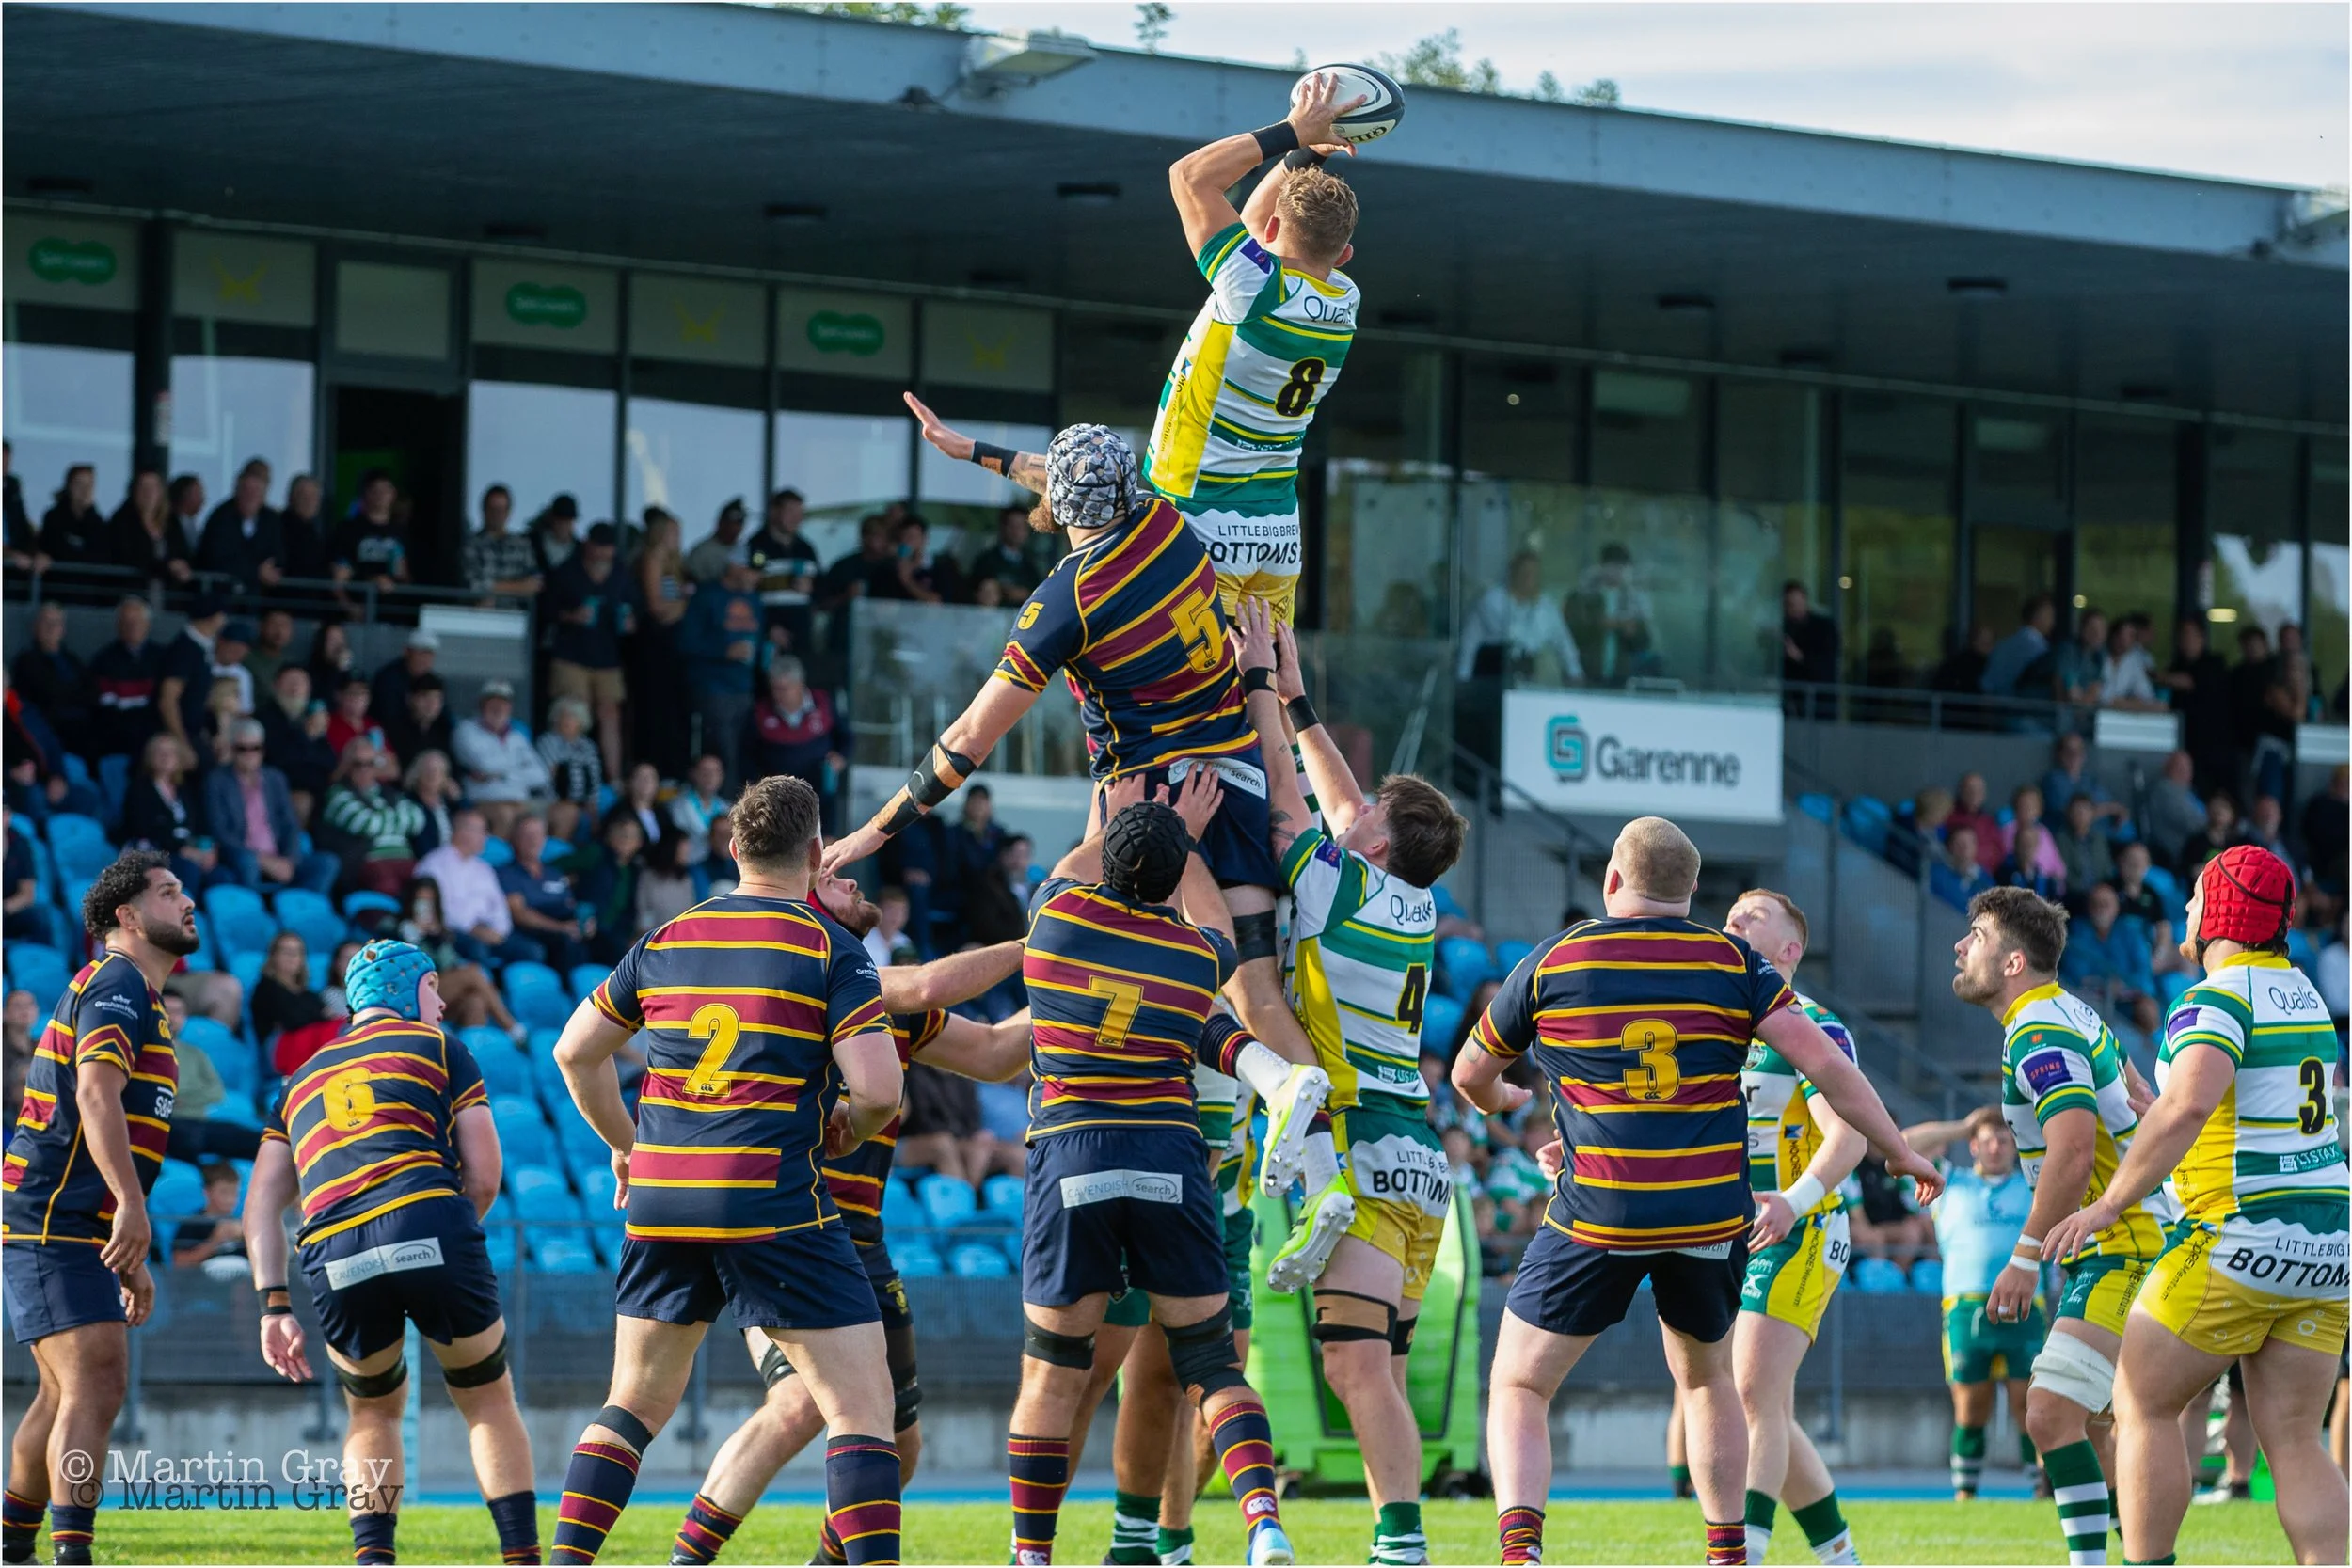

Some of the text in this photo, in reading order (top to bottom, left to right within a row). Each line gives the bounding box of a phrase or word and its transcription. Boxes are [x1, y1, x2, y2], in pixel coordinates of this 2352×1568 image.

[1275, 357, 1325, 418] 8
[1017, 602, 1044, 630] 5
[1168, 587, 1223, 673] 5
[1230, 768, 1262, 789] search
[1596, 734, 1740, 787] Garenne
[1089, 975, 1144, 1049] 7
[1395, 963, 1426, 1037] 4
[2268, 985, 2318, 1016] Qualis
[683, 1003, 740, 1098] 2
[1620, 1018, 1682, 1101] 3
[2029, 1060, 2061, 1081] SPRING
[323, 1066, 375, 1132] 6
[2298, 1056, 2327, 1136] 3
[1067, 1180, 1171, 1199] CAVENDISH search
[331, 1249, 431, 1282] CAVENDISH search
